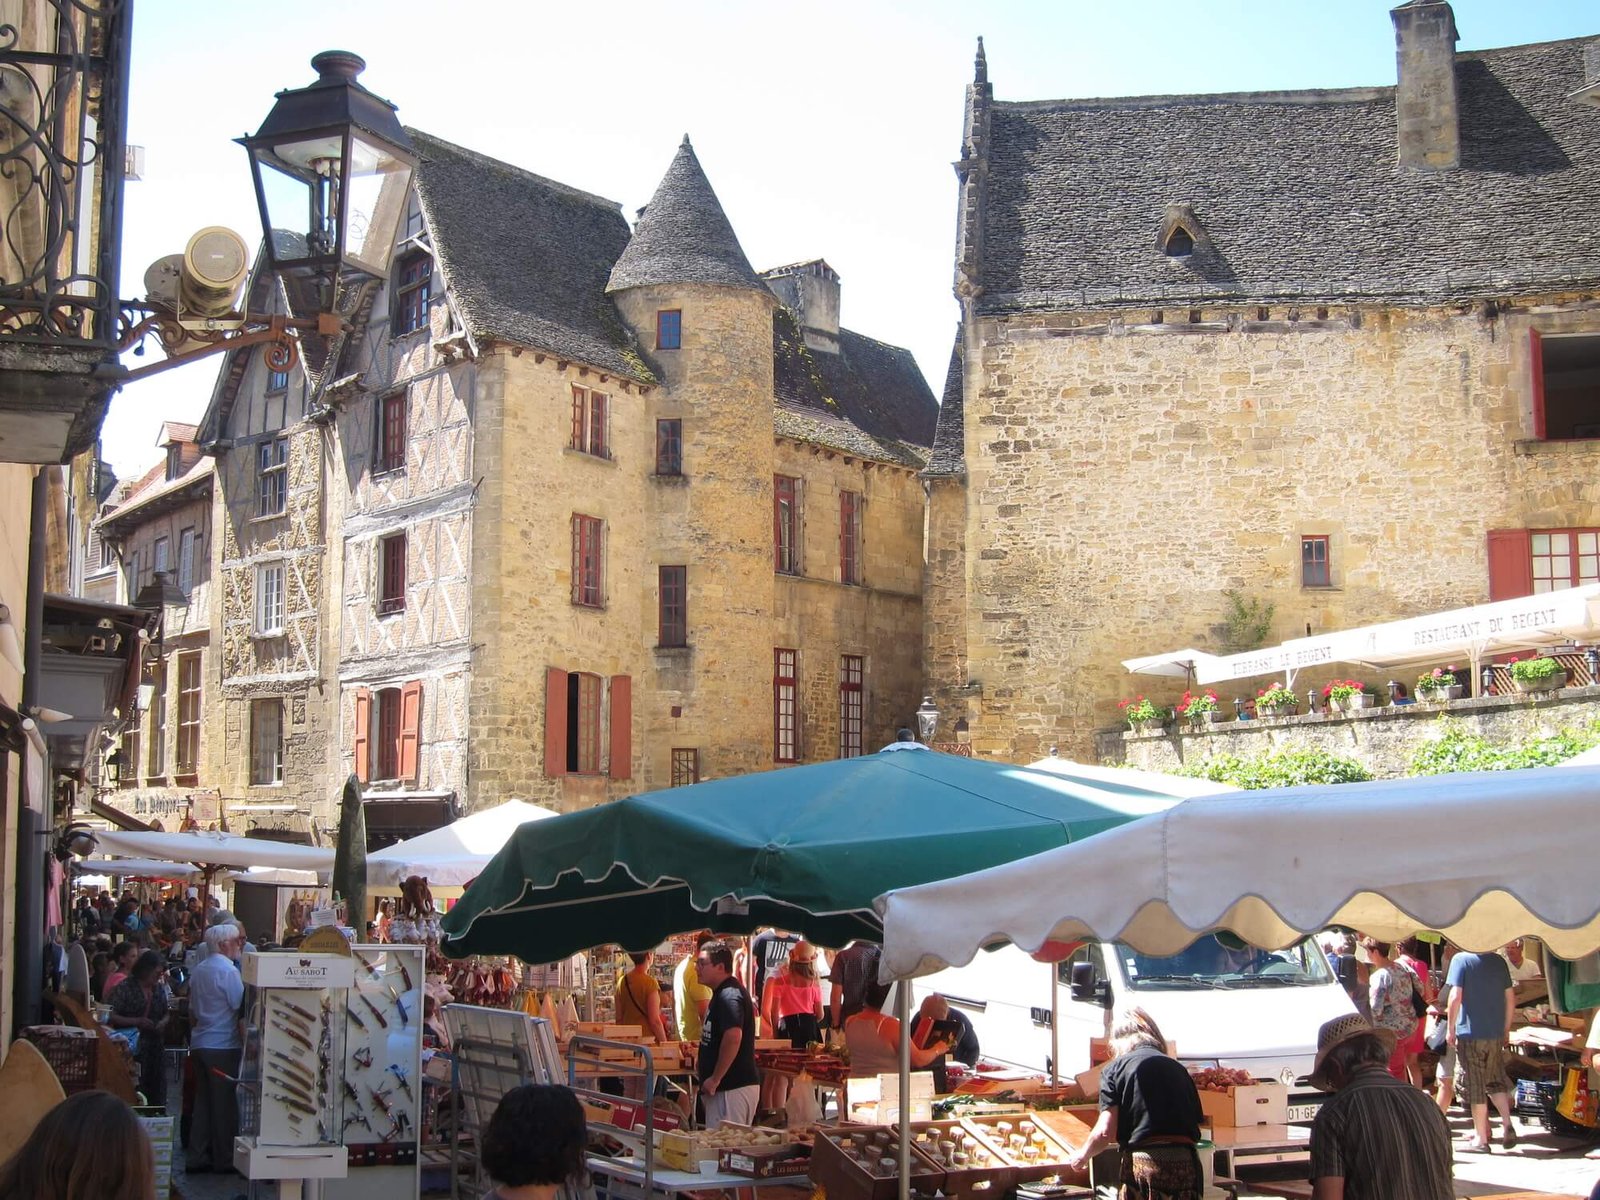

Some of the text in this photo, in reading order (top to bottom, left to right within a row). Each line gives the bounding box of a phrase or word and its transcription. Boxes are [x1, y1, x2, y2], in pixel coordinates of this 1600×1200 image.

[1414, 622, 1480, 646] RESTAURANT
[1489, 617, 1503, 633] DU
[1280, 652, 1291, 666] LE
